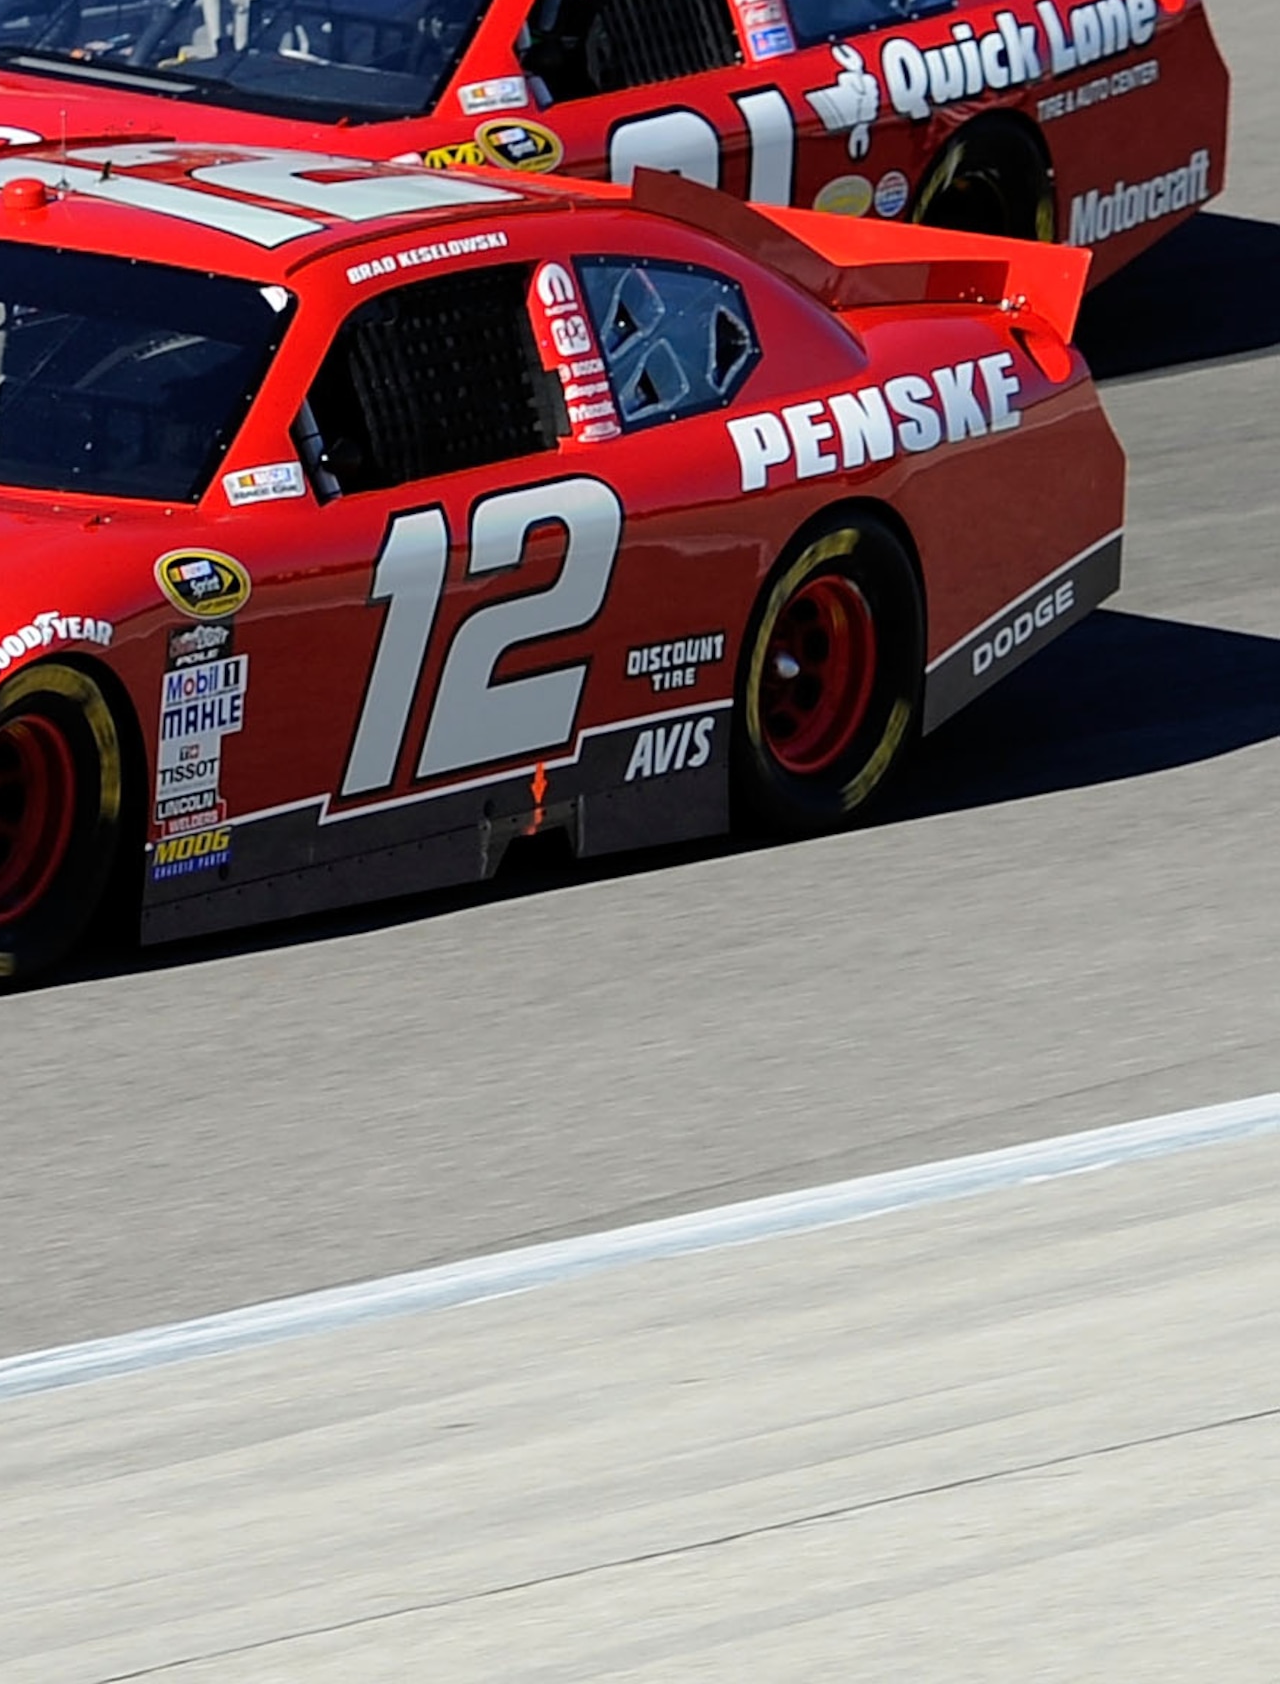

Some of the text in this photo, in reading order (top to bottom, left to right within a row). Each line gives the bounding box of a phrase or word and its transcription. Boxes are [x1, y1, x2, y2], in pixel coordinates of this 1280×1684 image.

[881, 10, 1043, 120] Quick
[1068, 149, 1210, 246] Motorcraft
[346, 231, 508, 285] BRAD KESELOWSKI
[726, 351, 1022, 493] PENSKE
[190, 576, 221, 599] Sprint
[339, 476, 623, 797] 12
[972, 579, 1075, 676] DODGE
[627, 633, 725, 676] DISCOUNT
[166, 664, 218, 702] Mobil
[652, 668, 696, 692] TIRE
[161, 694, 241, 741] MAHLE
[159, 757, 218, 786] TISSOT
[624, 716, 715, 781] AVIS
[157, 790, 214, 818] LINCOLN
[153, 827, 232, 865] MOOG
